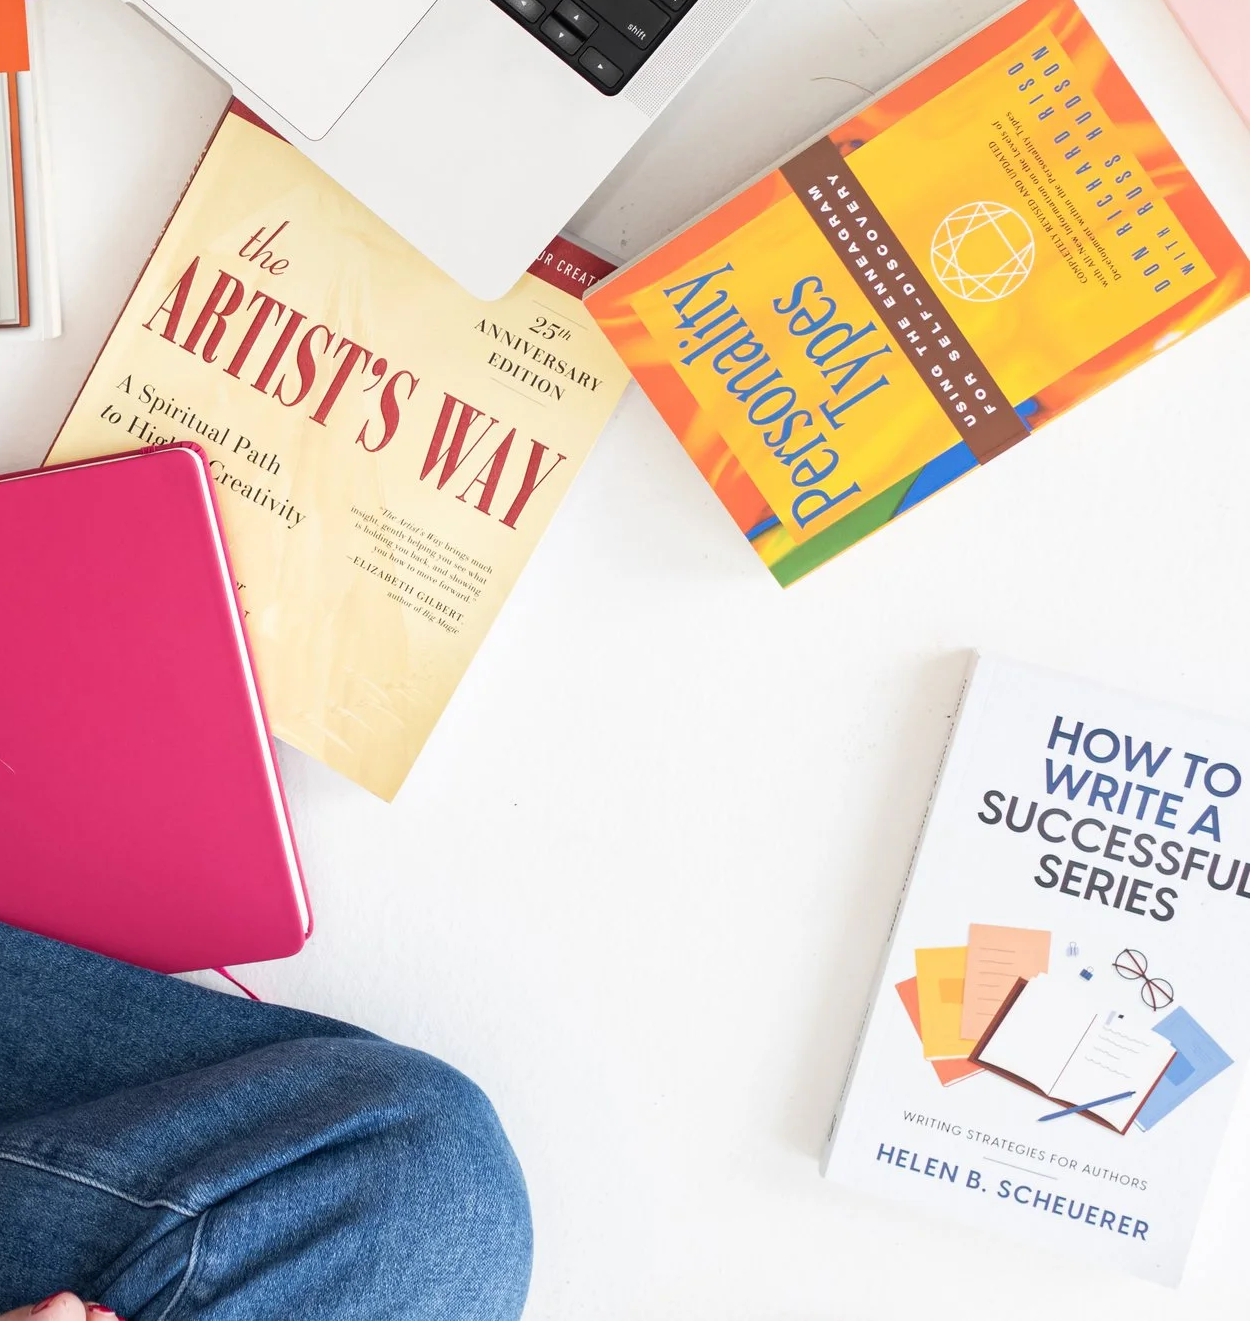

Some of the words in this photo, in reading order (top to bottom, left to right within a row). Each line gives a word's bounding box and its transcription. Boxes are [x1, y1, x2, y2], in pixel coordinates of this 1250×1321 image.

[1007, 61, 1055, 122] RISO
[1031, 45, 1103, 141] HUDSON
[988, 141, 1017, 180] UPDATED
[1014, 179, 1031, 198] AND
[1053, 130, 1133, 238] RICHARD
[1103, 154, 1154, 217] RUSS
[238, 220, 290, 276] the
[807, 185, 897, 309] ENNEAGRAM
[1027, 198, 1054, 233] REVISED
[826, 174, 961, 362] SELF-DISCOVERY
[1052, 234, 1088, 284] COMPLETELY
[1131, 246, 1171, 293] DON
[1156, 226, 1196, 276] WITH
[474, 319, 602, 392] ANNIVERSARY
[528, 317, 571, 341] 25th
[773, 275, 893, 430] Types
[897, 316, 928, 357] THE
[141, 255, 421, 453] ARTIST'S
[419, 391, 567, 531] WAY
[488, 352, 562, 401] EDITION
[662, 262, 862, 530] Personality
[931, 364, 977, 428] USING
[964, 372, 997, 415] FOR
[117, 374, 132, 394] A
[138, 384, 230, 446] Spiritual
[232, 435, 281, 475] Path
[100, 404, 122, 424] to
[208, 460, 307, 530] Creativity
[386, 591, 412, 608] author
[413, 606, 423, 614] of
[422, 609, 436, 623] Big
[437, 617, 460, 634] Magic
[1046, 715, 1173, 778] HOW
[1183, 751, 1242, 798] TO
[1045, 757, 1184, 830] WRITE
[1187, 804, 1221, 843] A
[977, 789, 1250, 900] SUCCESSFUL
[1033, 853, 1179, 922] SERIES
[903, 1110, 962, 1136] WRITING
[966, 1129, 1046, 1161] STRATEGIES
[1049, 1153, 1078, 1170] FOR
[1081, 1164, 1148, 1191] AUTHORS
[876, 1143, 959, 1183] HELEN
[965, 1169, 986, 1193] B.
[997, 1179, 1149, 1241] SCHEUERER
